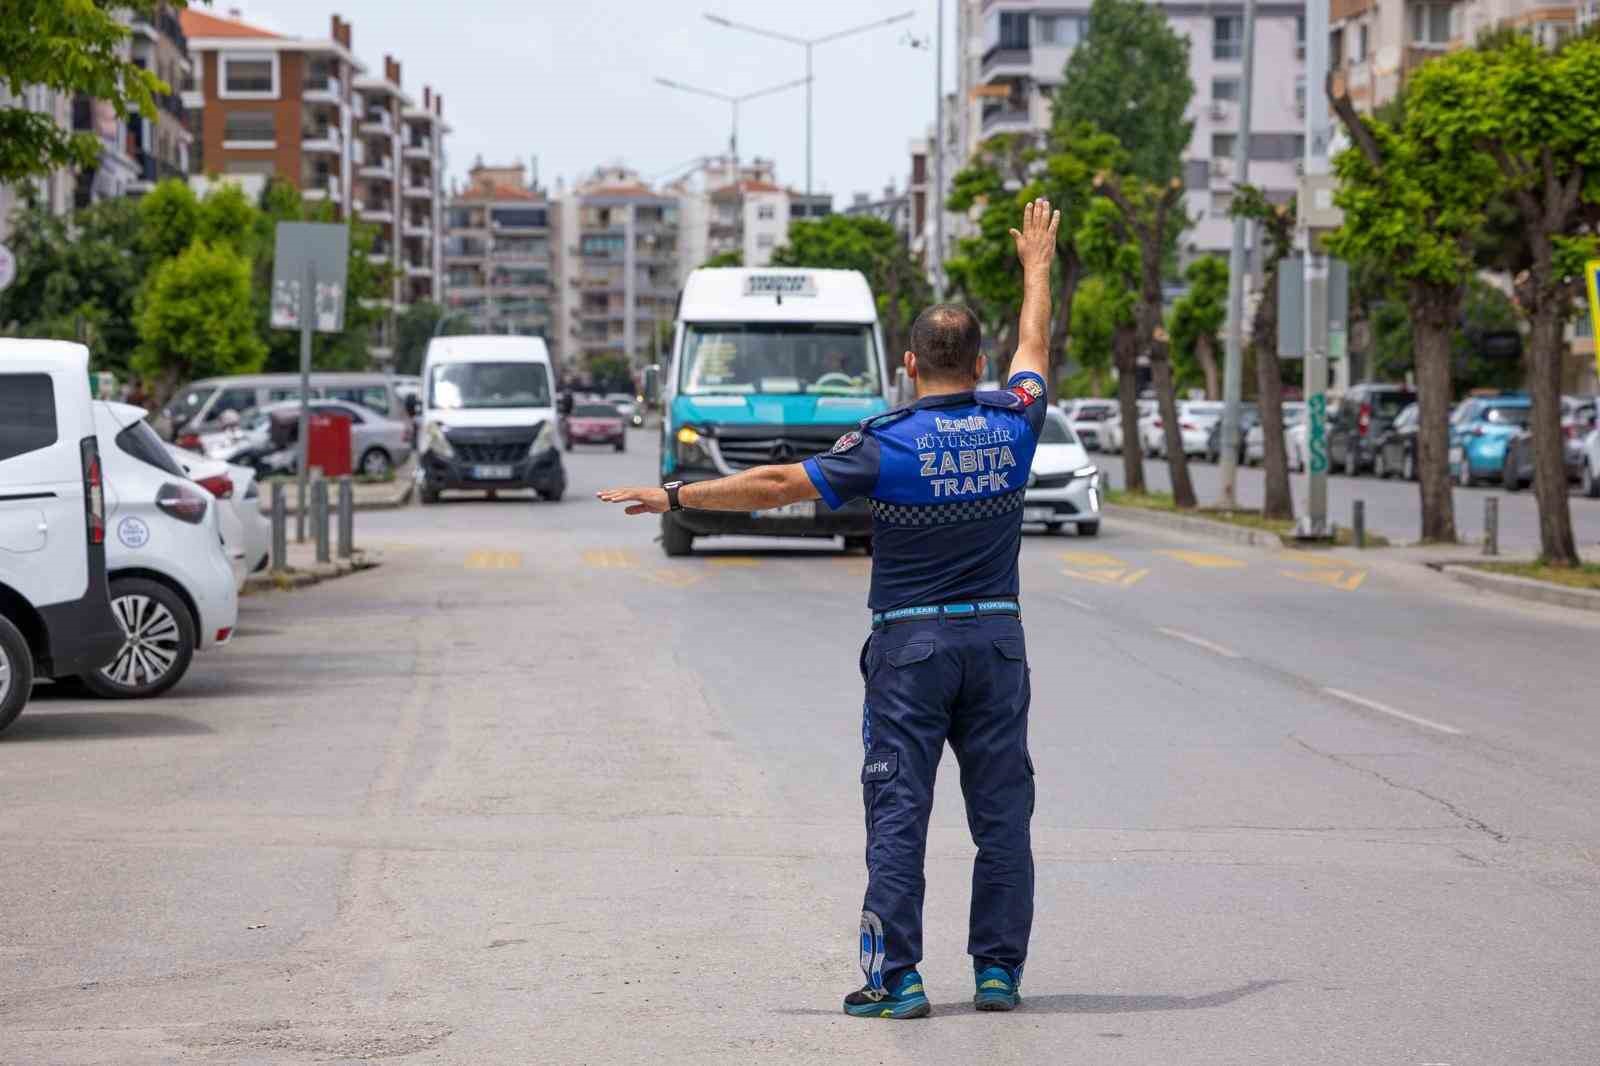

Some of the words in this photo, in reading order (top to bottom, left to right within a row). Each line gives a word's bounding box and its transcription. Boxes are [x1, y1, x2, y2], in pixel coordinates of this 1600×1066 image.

[935, 416, 988, 432] İZMİR
[915, 428, 1014, 450] BÜYÜKŞEHİR
[919, 446, 1016, 476] ZABITA
[930, 471, 1009, 497] TRAFİK
[865, 761, 889, 773] AFİK
